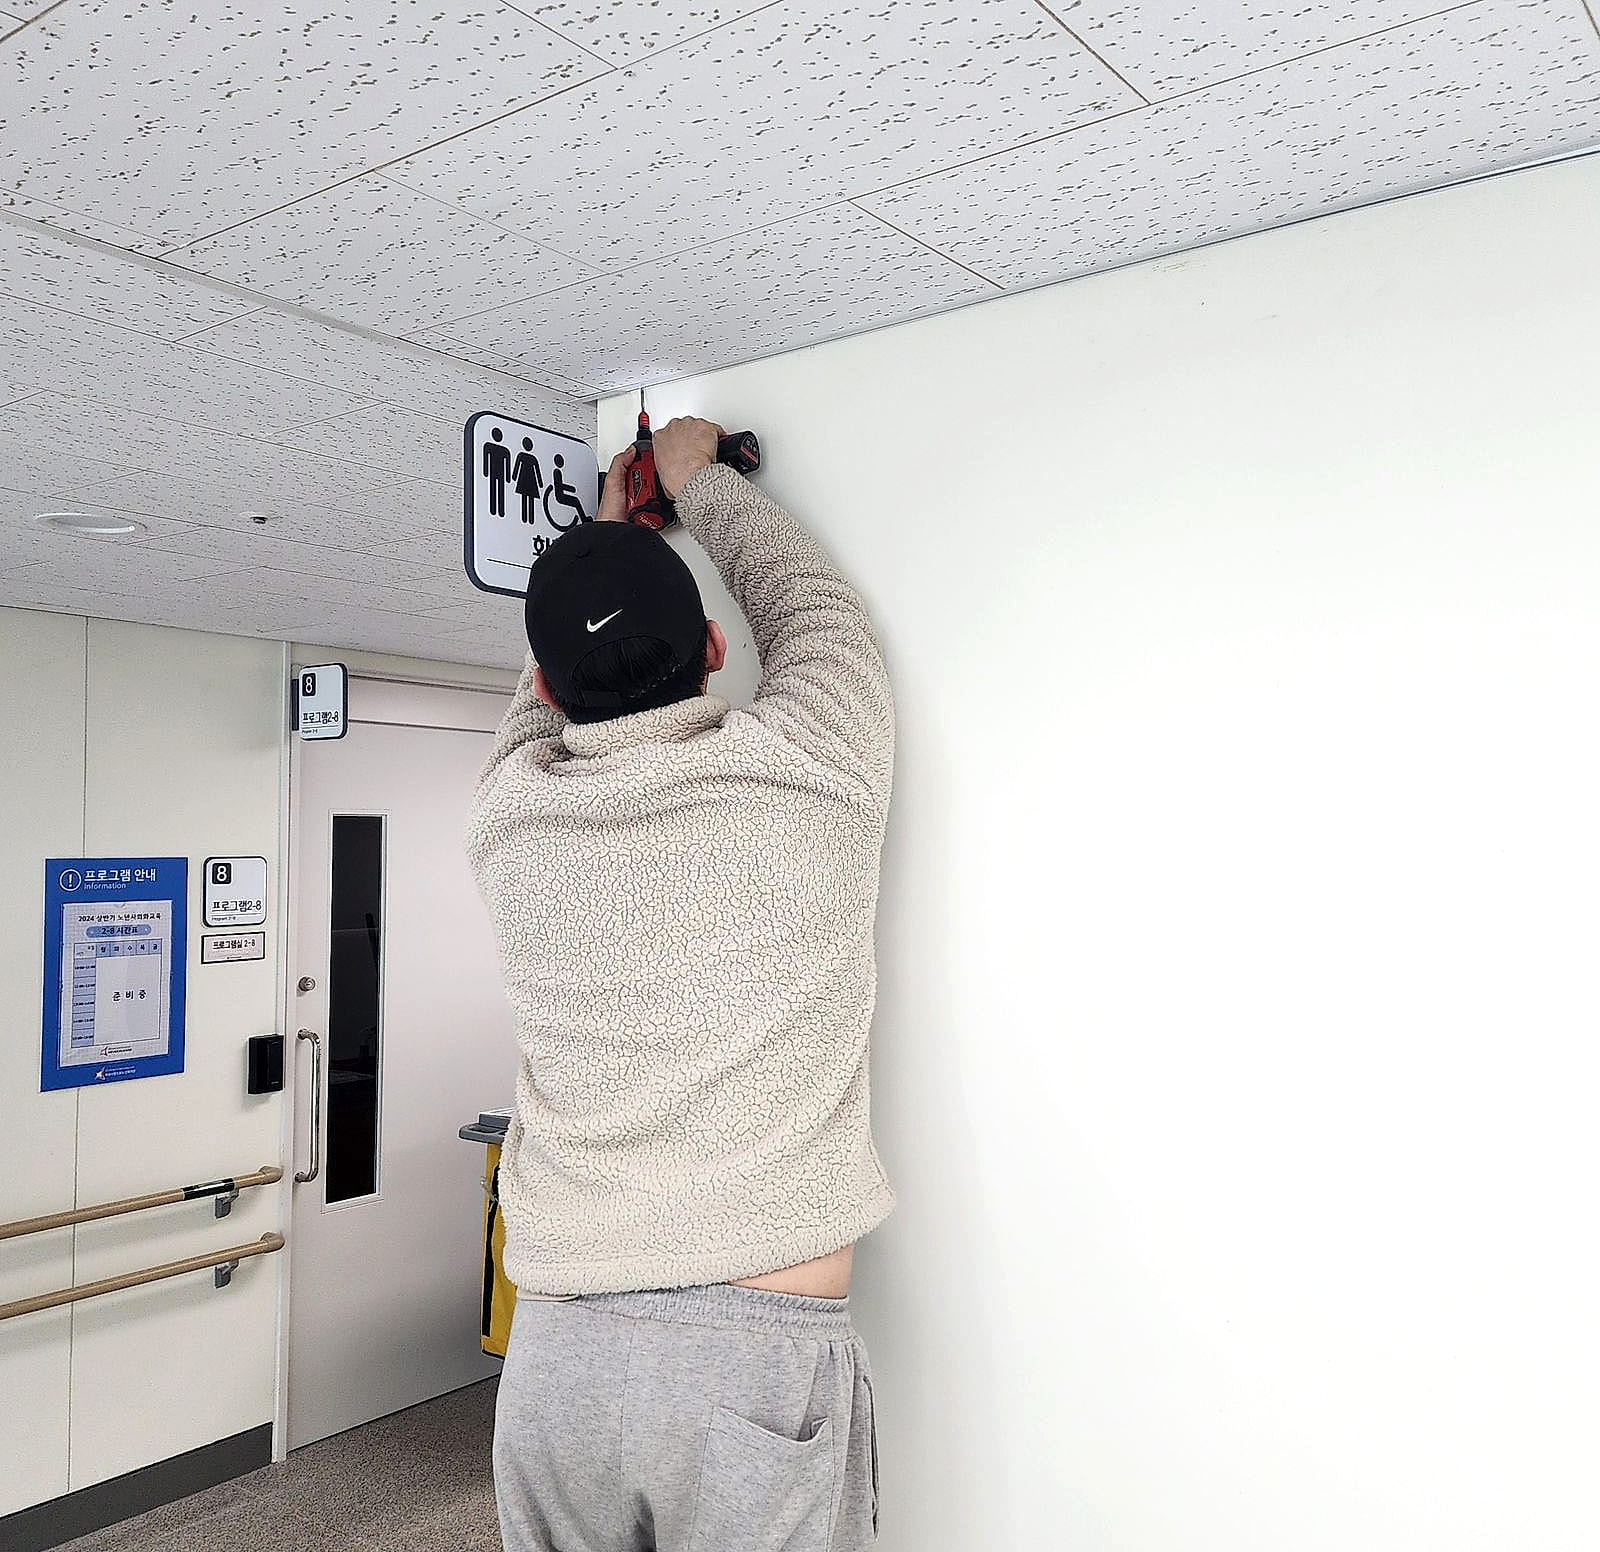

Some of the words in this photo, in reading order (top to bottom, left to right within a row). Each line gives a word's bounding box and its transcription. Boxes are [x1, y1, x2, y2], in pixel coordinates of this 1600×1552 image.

[306, 676, 313, 693] 8
[302, 711, 339, 725] 프로그램2-8
[84, 869, 131, 882] 프로그램
[134, 868, 156, 882] 안내
[217, 865, 227, 881] 8
[212, 900, 262, 912] 프로그램2-8
[96, 914, 116, 922] 상반기
[116, 926, 138, 935] 시간표
[213, 940, 243, 949] 프로그램실
[244, 939, 256, 947] 2-8
[125, 990, 134, 999] 비
